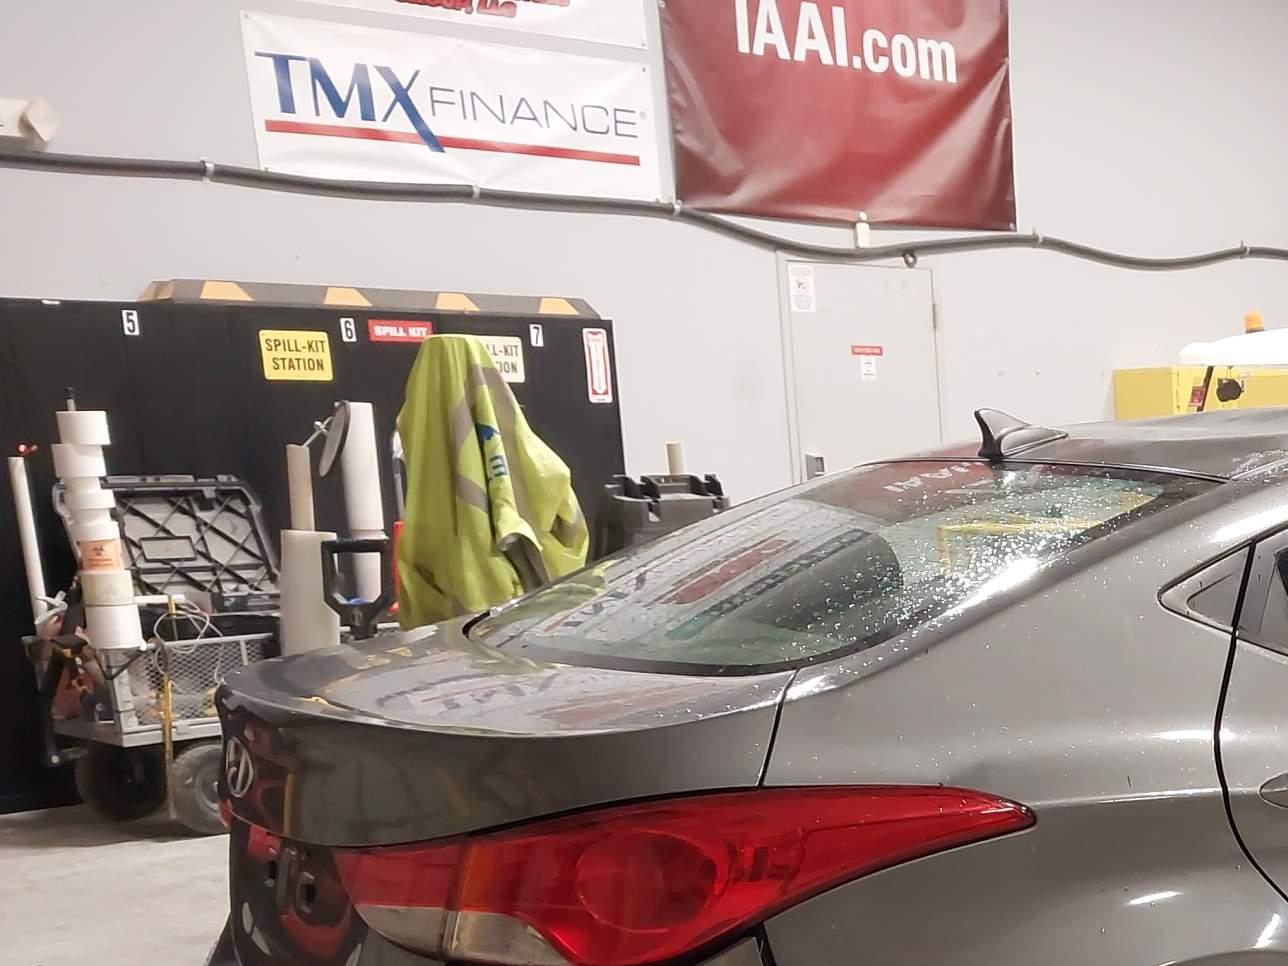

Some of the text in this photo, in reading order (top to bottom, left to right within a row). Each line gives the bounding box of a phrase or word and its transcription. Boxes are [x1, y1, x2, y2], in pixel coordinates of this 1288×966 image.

[735, 0, 957, 83] IAAI.com
[254, 51, 640, 153] TMX FINANCE
[126, 311, 136, 334] 5
[344, 319, 353, 340] 6
[373, 325, 428, 337] SPILL KIT
[532, 326, 540, 345] 7
[265, 338, 326, 354] SPILL-KIT
[272, 357, 325, 372] STATION
